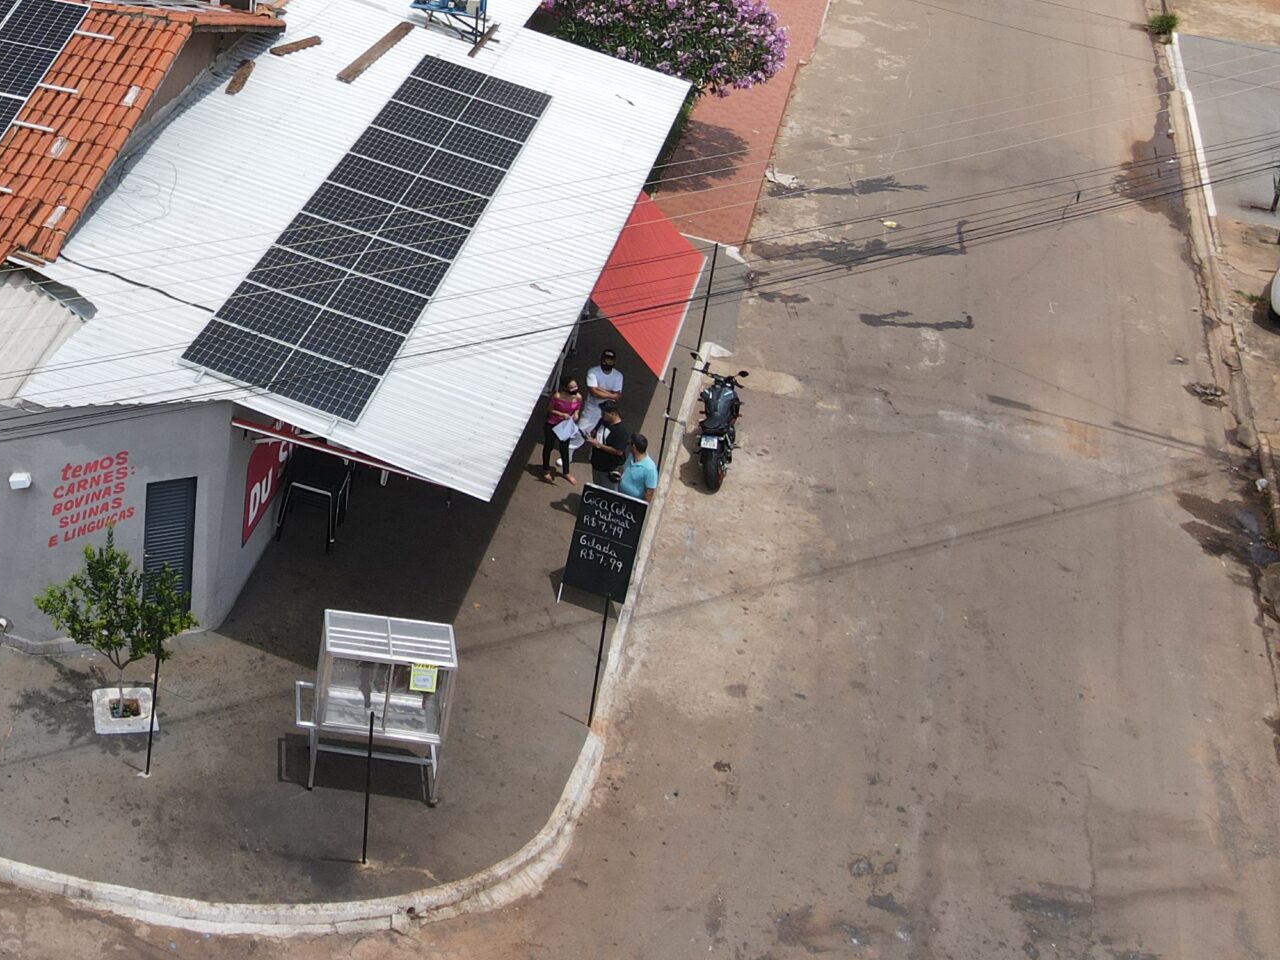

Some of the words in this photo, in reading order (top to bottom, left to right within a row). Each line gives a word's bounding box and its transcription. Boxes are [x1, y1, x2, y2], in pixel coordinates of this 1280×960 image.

[51, 482, 125, 516] BOVINAS
[53, 466, 136, 499] CARNES:
[59, 497, 123, 528] SUINAS
[583, 490, 609, 511] Coca
[610, 501, 636, 523] Cola
[48, 534, 58, 548] E
